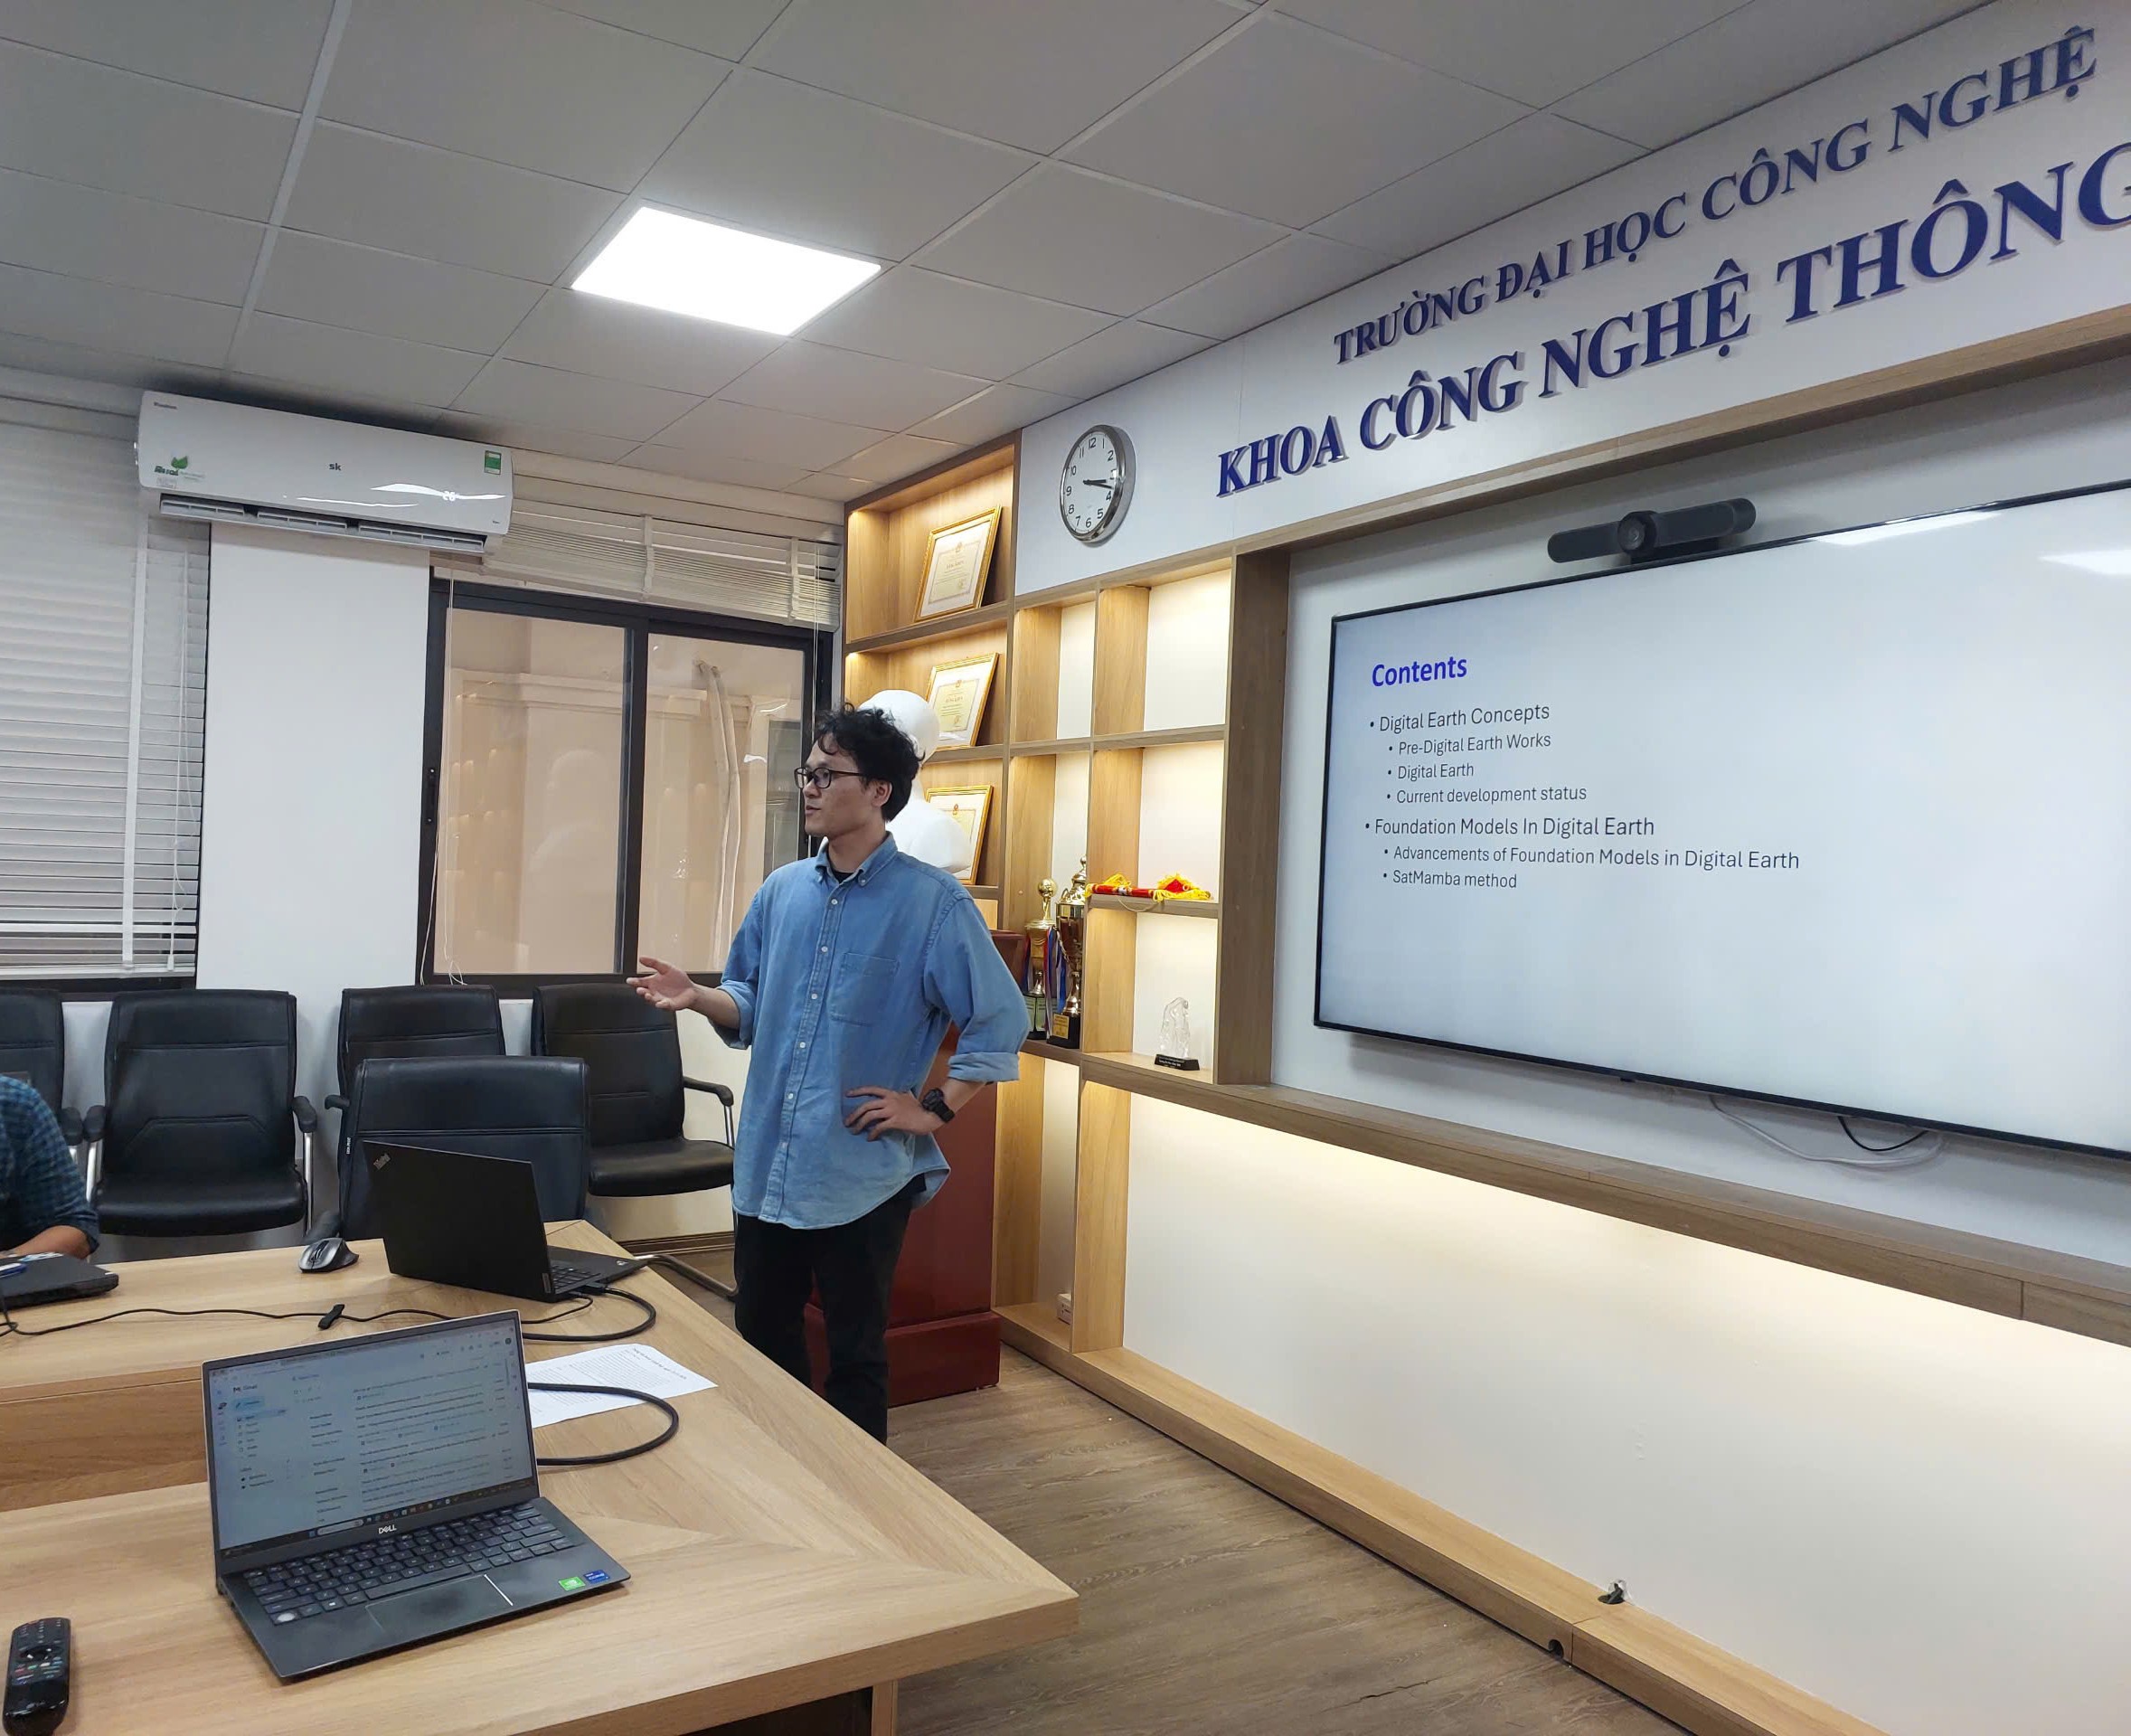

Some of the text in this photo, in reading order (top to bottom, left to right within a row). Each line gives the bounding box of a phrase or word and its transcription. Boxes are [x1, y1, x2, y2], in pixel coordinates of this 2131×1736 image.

[1333, 24, 2098, 364] TRƯỜNG ĐẠI HỌC CÔNG NGHỆ
[1216, 142, 2131, 497] KHOA CÔNG NGHỆ THÔNG
[1372, 656, 1468, 687] Contents
[1380, 703, 1551, 734] Digital Earth Concepts
[1399, 732, 1551, 757] Pre-Digital Earth Works
[1398, 762, 1475, 782] Digital Earth
[1396, 786, 1588, 805] Current development status
[1374, 816, 1655, 839] Foundation Models In Digital Earth
[1393, 845, 1799, 871] Advancements of Foundation Models in Digital Earth
[1392, 870, 1517, 888] SatMamba method
